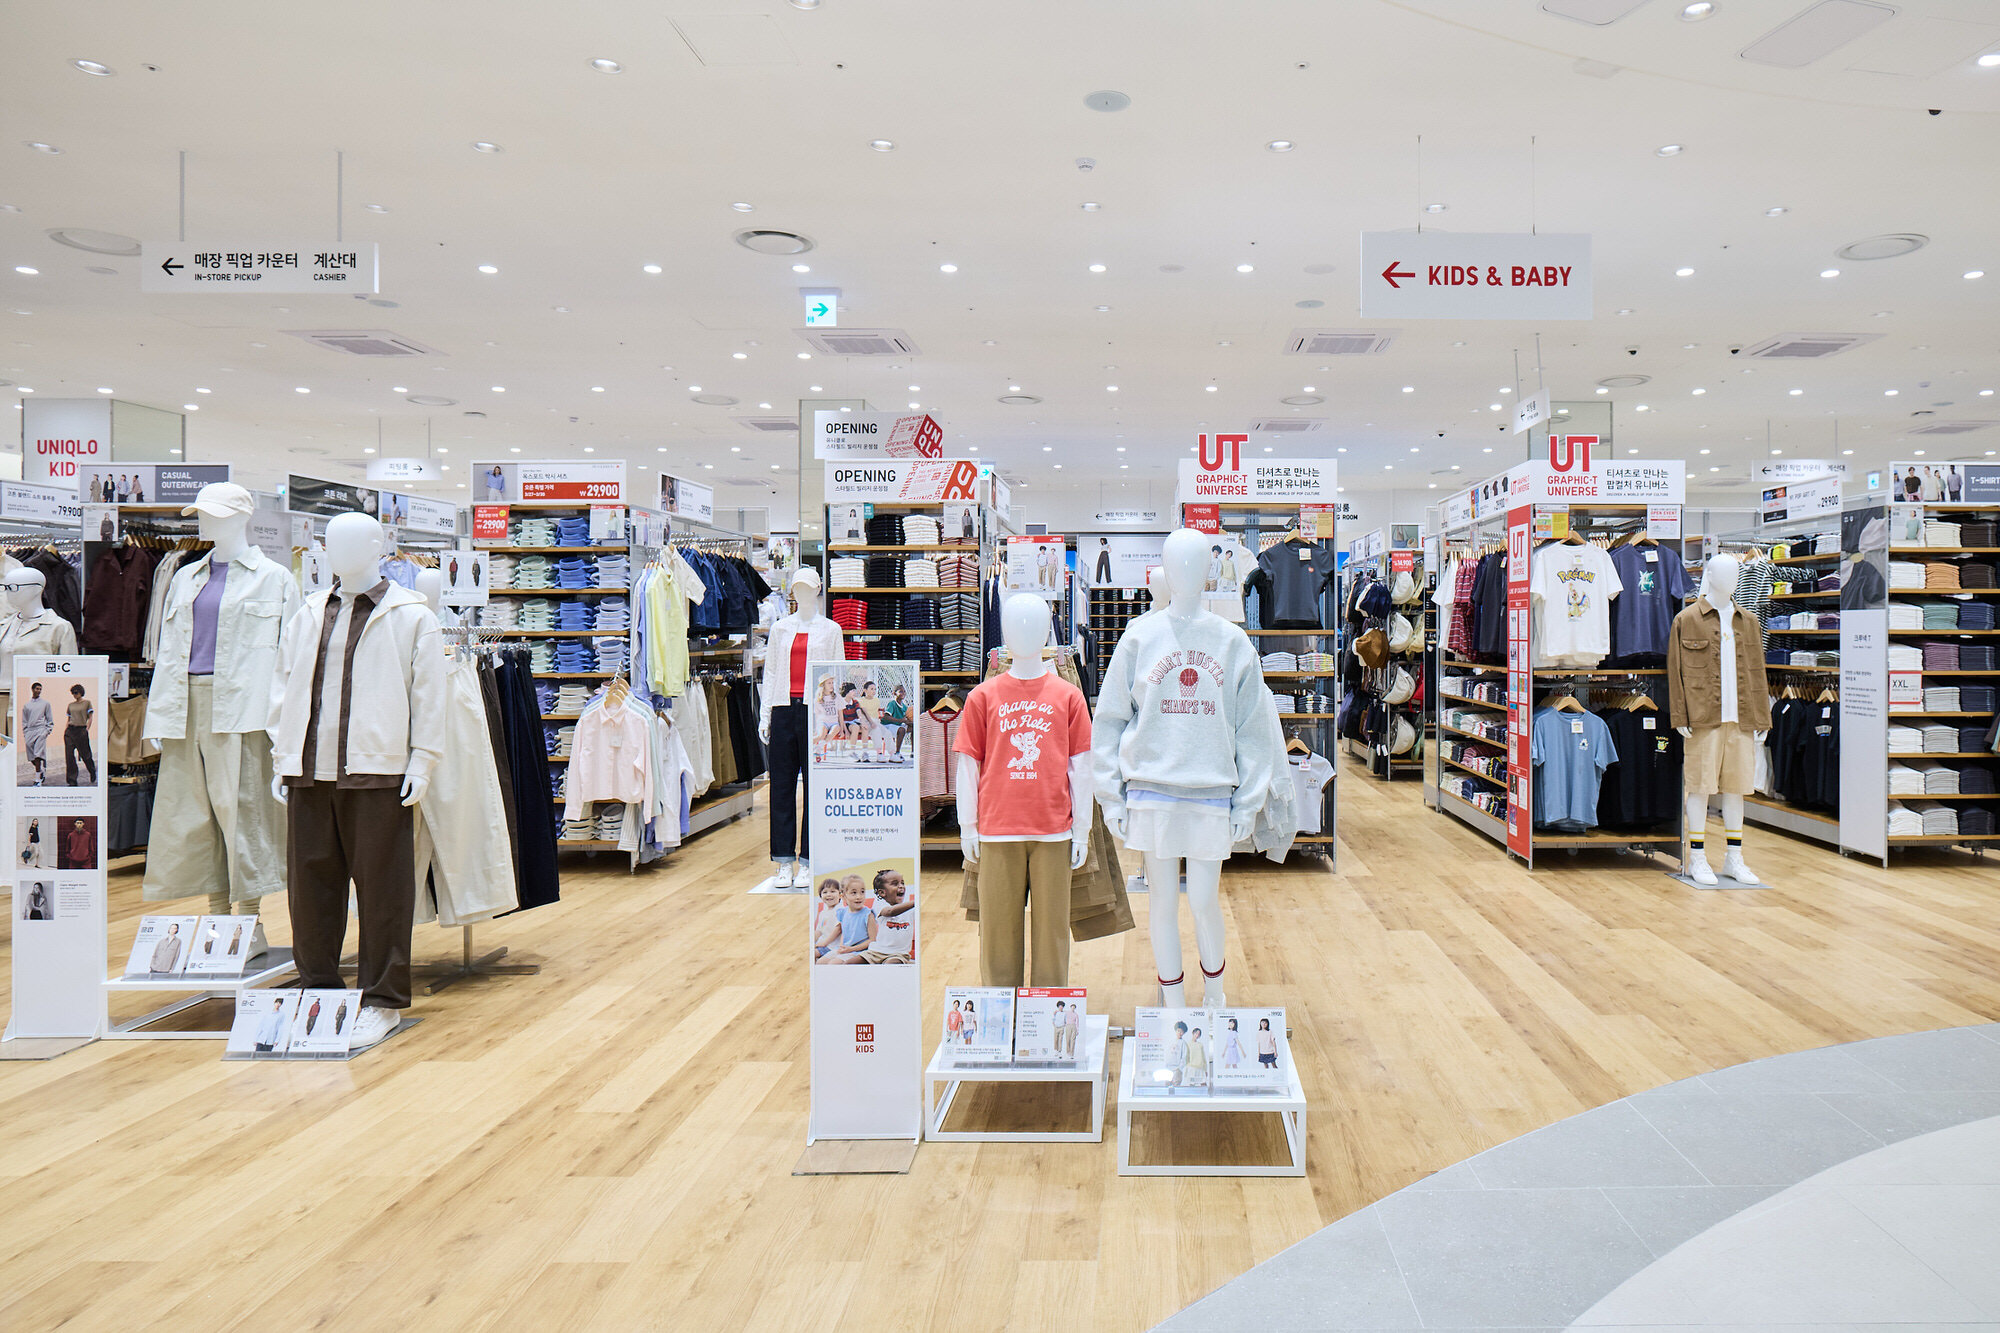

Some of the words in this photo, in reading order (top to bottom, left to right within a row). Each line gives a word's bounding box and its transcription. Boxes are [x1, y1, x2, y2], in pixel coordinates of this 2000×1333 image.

[194, 252, 221, 269] 매장
[225, 252, 252, 269] 픽업
[257, 252, 298, 269] 카운터
[313, 252, 356, 269] 계산대
[194, 273, 231, 281] IN-STORE
[234, 273, 262, 281] PICKUP
[313, 273, 346, 281] CASHIER
[1428, 265, 1478, 286] KIDS
[1486, 266, 1503, 286] &
[1511, 266, 1572, 287] BABY
[826, 423, 878, 434] OPENING
[37, 439, 98, 457] UNIQLO
[1198, 434, 1248, 471] UT
[1550, 435, 1598, 472] UT
[49, 461, 79, 477] KID
[161, 471, 192, 479] CASUAL
[1256, 468, 1292, 477] 티셔츠로
[1294, 468, 1320, 477] 만나는
[1606, 469, 1641, 478] 티셔츠로
[1643, 469, 1669, 478] 만나는
[835, 469, 896, 483] OPENING
[1196, 485, 1248, 495] UNIVERSE
[1256, 479, 1283, 489] 팝컬처
[1285, 479, 1320, 489] 유니버스
[1606, 480, 1632, 490] 팝컬처
[1635, 480, 1669, 490] 유니버스
[1547, 486, 1598, 496] UNIVERSE
[1512, 531, 1525, 558] UT
[1147, 651, 1182, 685] COURT
[1892, 679, 1909, 688] XXL
[998, 700, 1038, 718] Champ
[1038, 703, 1054, 715] on
[1160, 699, 1199, 714] CHAMPS
[1000, 718, 1018, 733] the
[1019, 714, 1052, 733] Field
[1010, 771, 1025, 780] SINCE
[825, 788, 902, 800] KIDS&BABY
[825, 805, 903, 817] COLLECTION
[857, 1033, 873, 1041] QLO
[855, 1045, 875, 1053] KIDS
